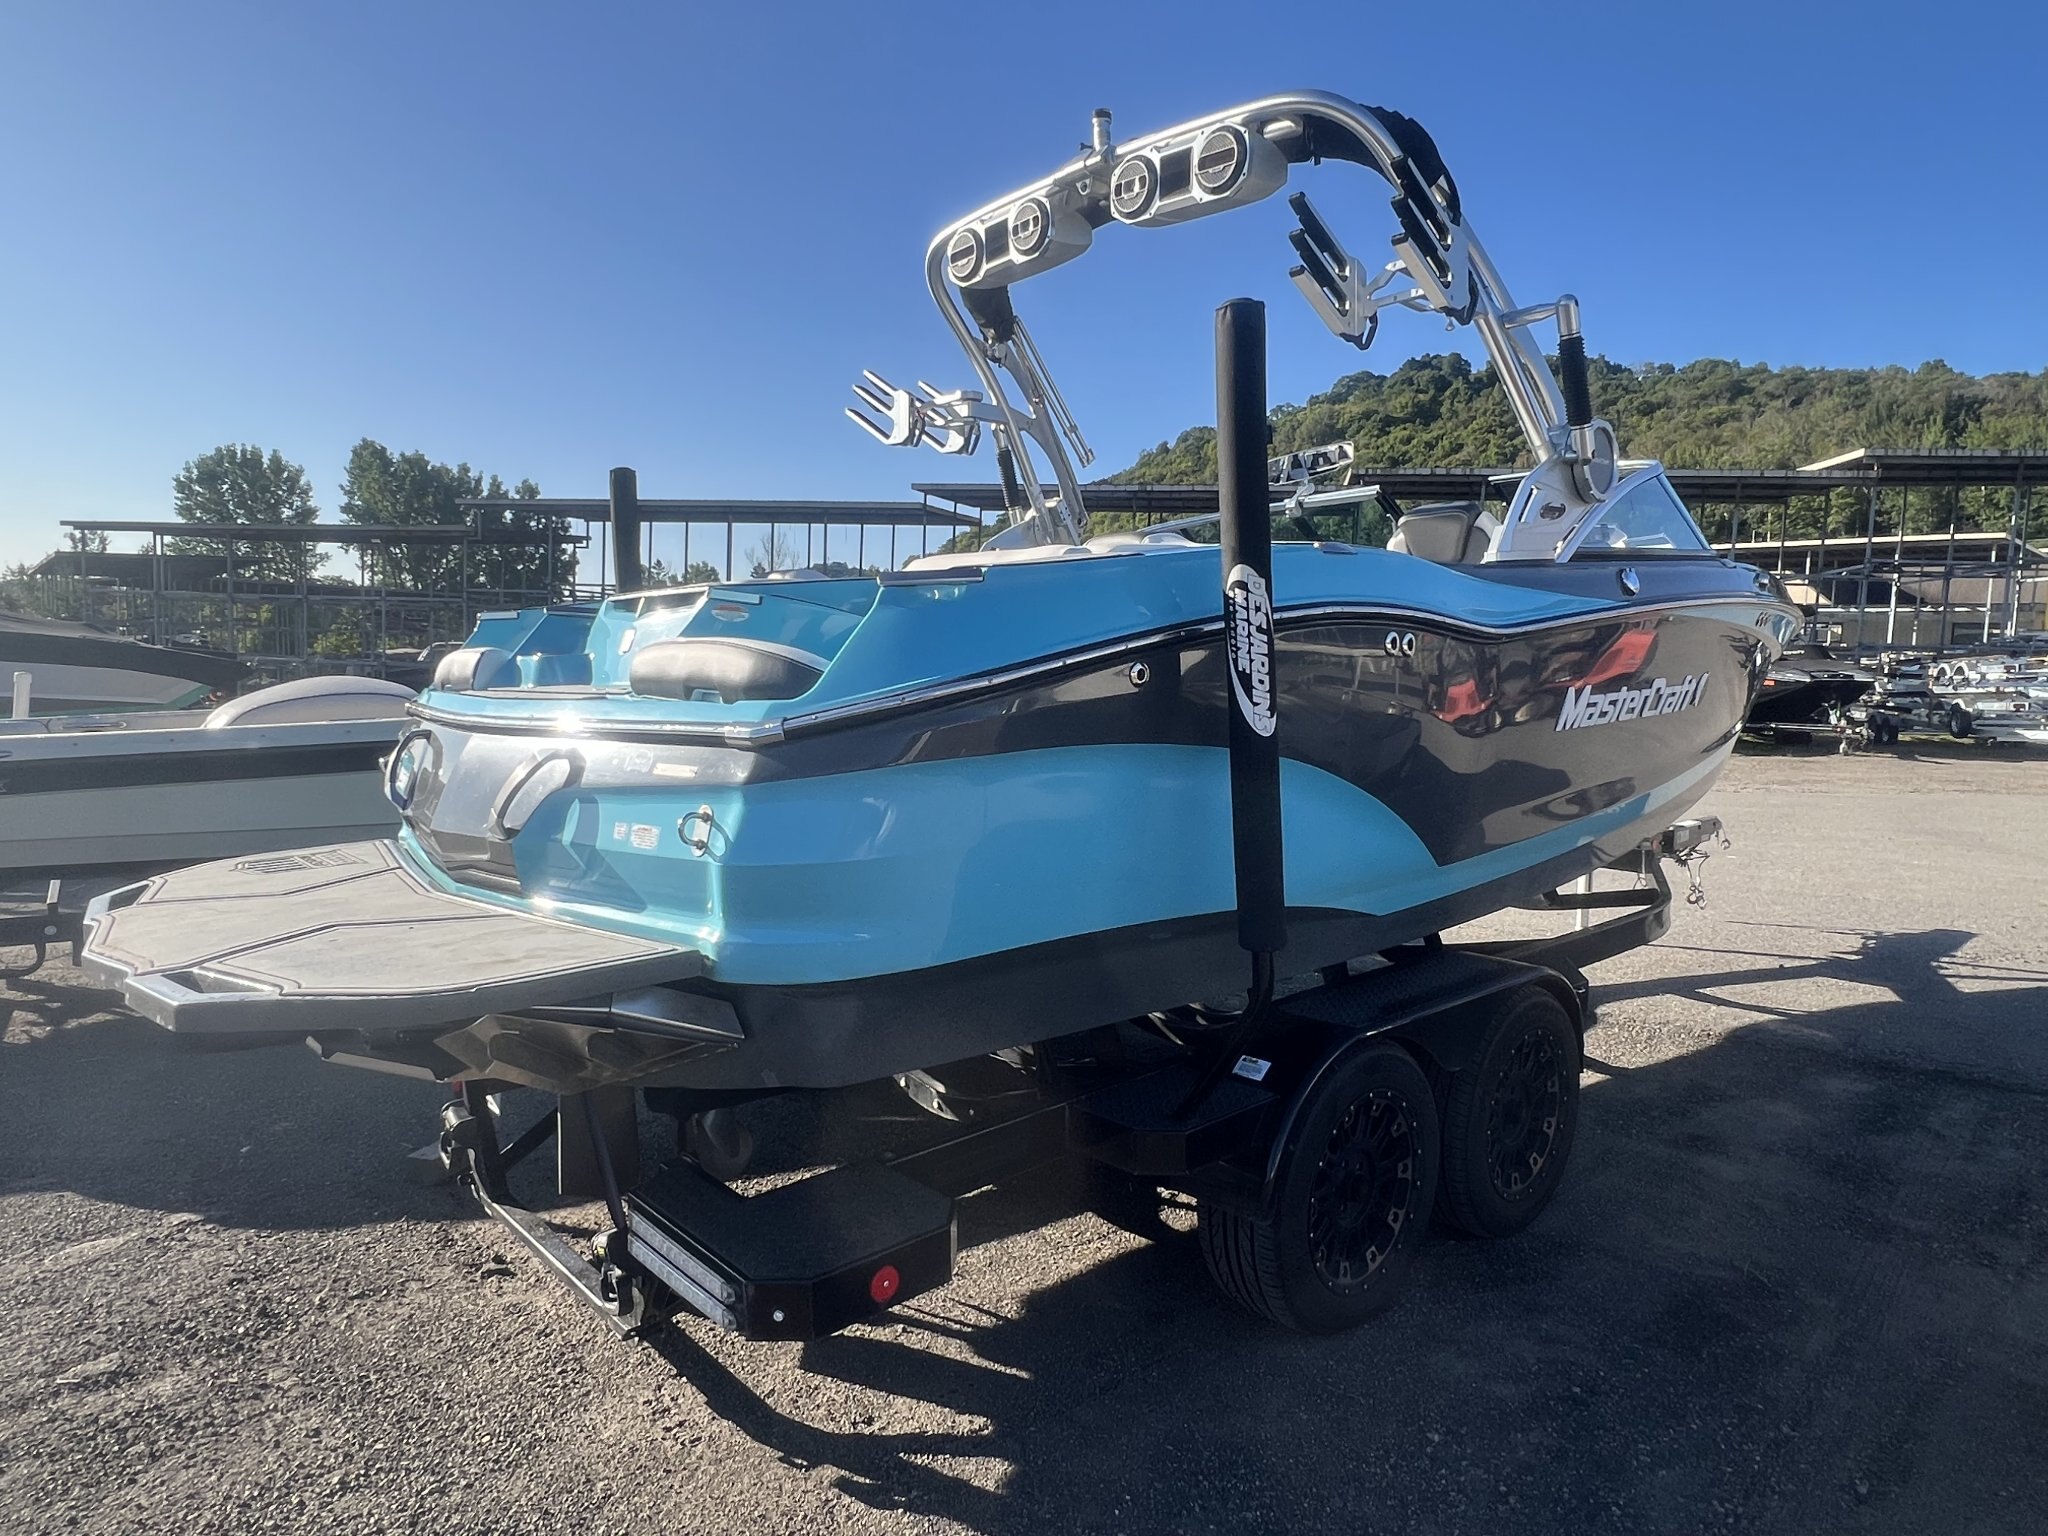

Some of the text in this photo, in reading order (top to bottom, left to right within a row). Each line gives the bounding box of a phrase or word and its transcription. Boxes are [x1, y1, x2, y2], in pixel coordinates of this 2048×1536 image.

[1234, 587, 1250, 674] MARINE
[1247, 573, 1271, 735] DESJARDINS
[1554, 674, 1698, 732] MasterCraft
